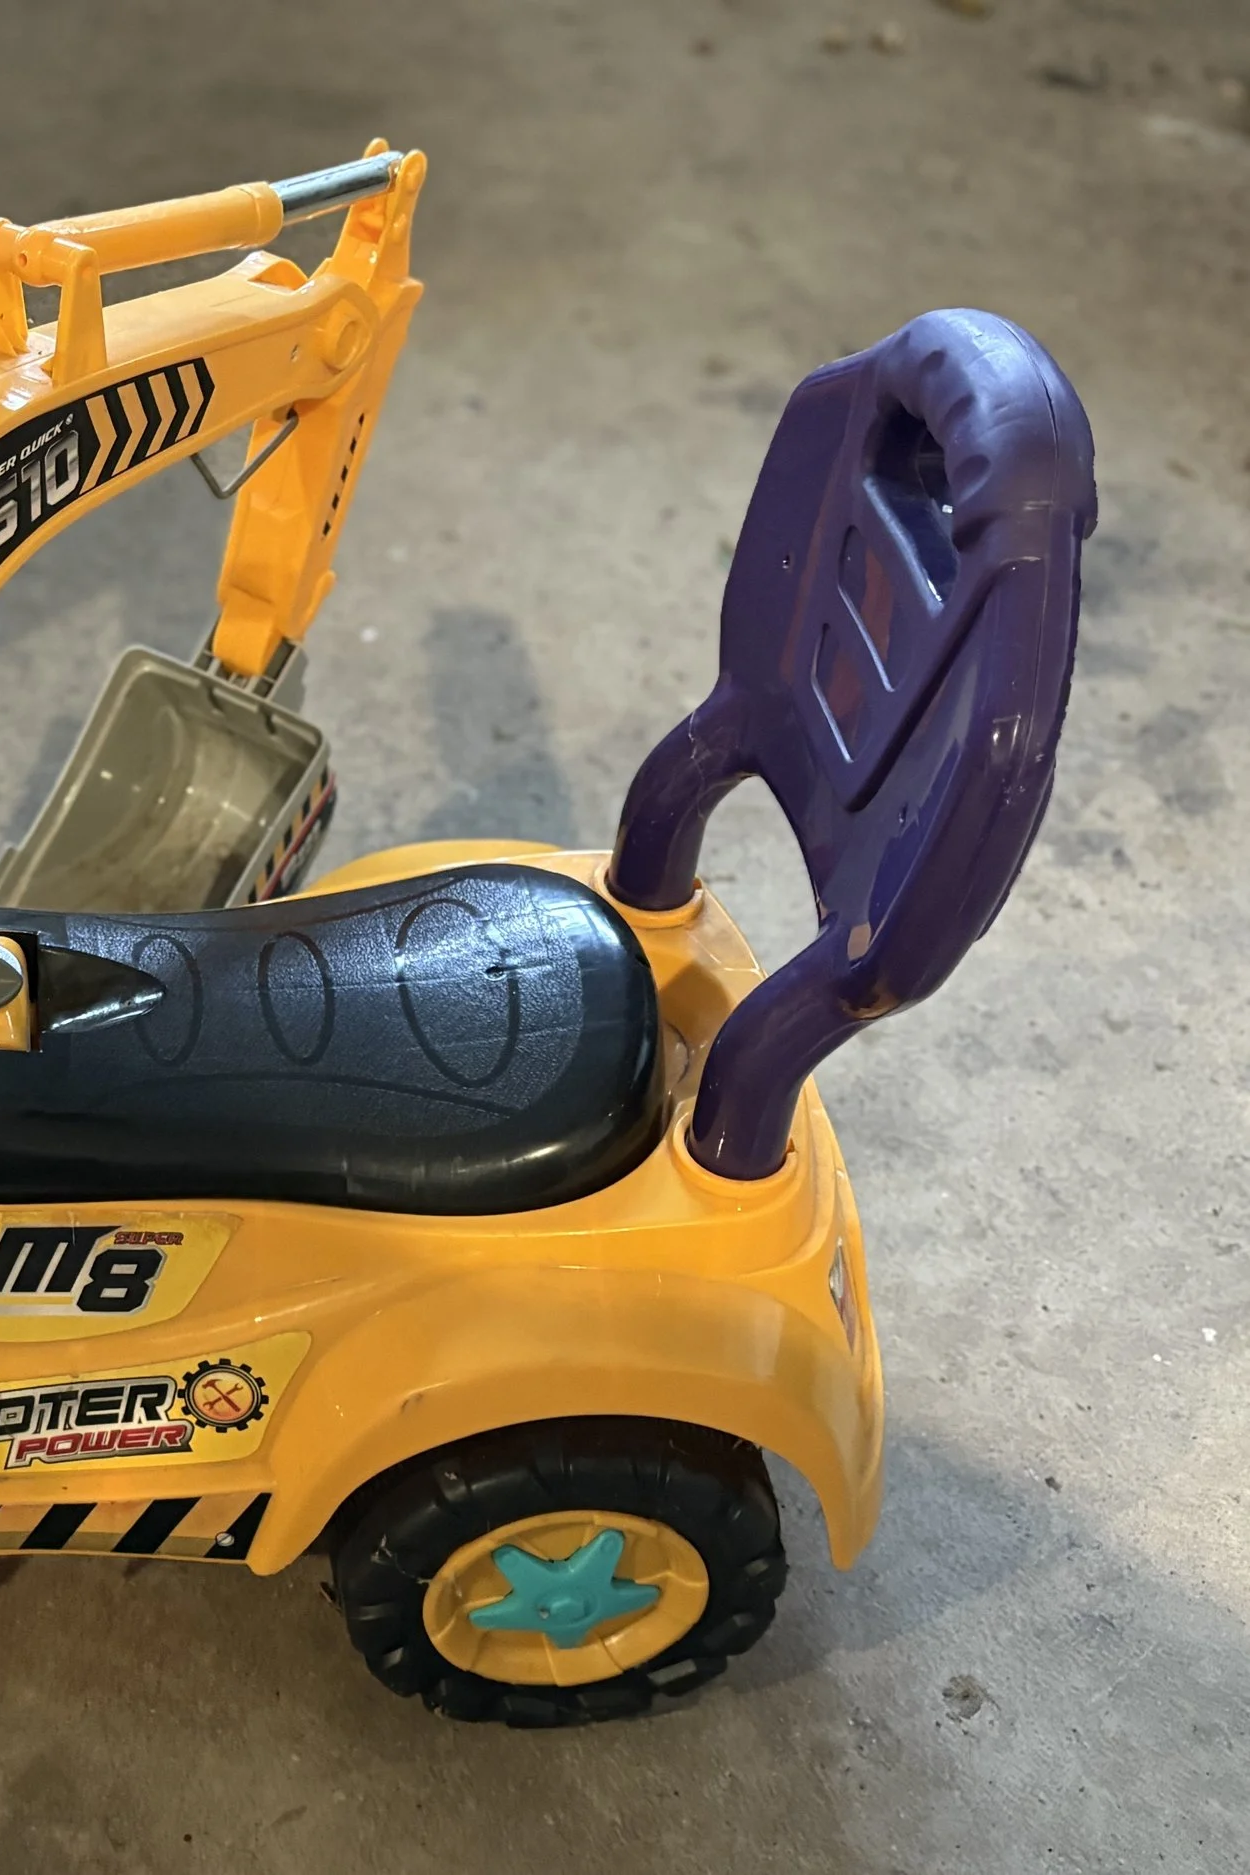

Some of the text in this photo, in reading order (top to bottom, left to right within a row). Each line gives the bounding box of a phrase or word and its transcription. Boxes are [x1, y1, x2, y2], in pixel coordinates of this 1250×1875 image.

[20, 419, 65, 460] QUICK
[114, 1231, 184, 1246] SUPER
[12, 1423, 188, 1464] POWER
